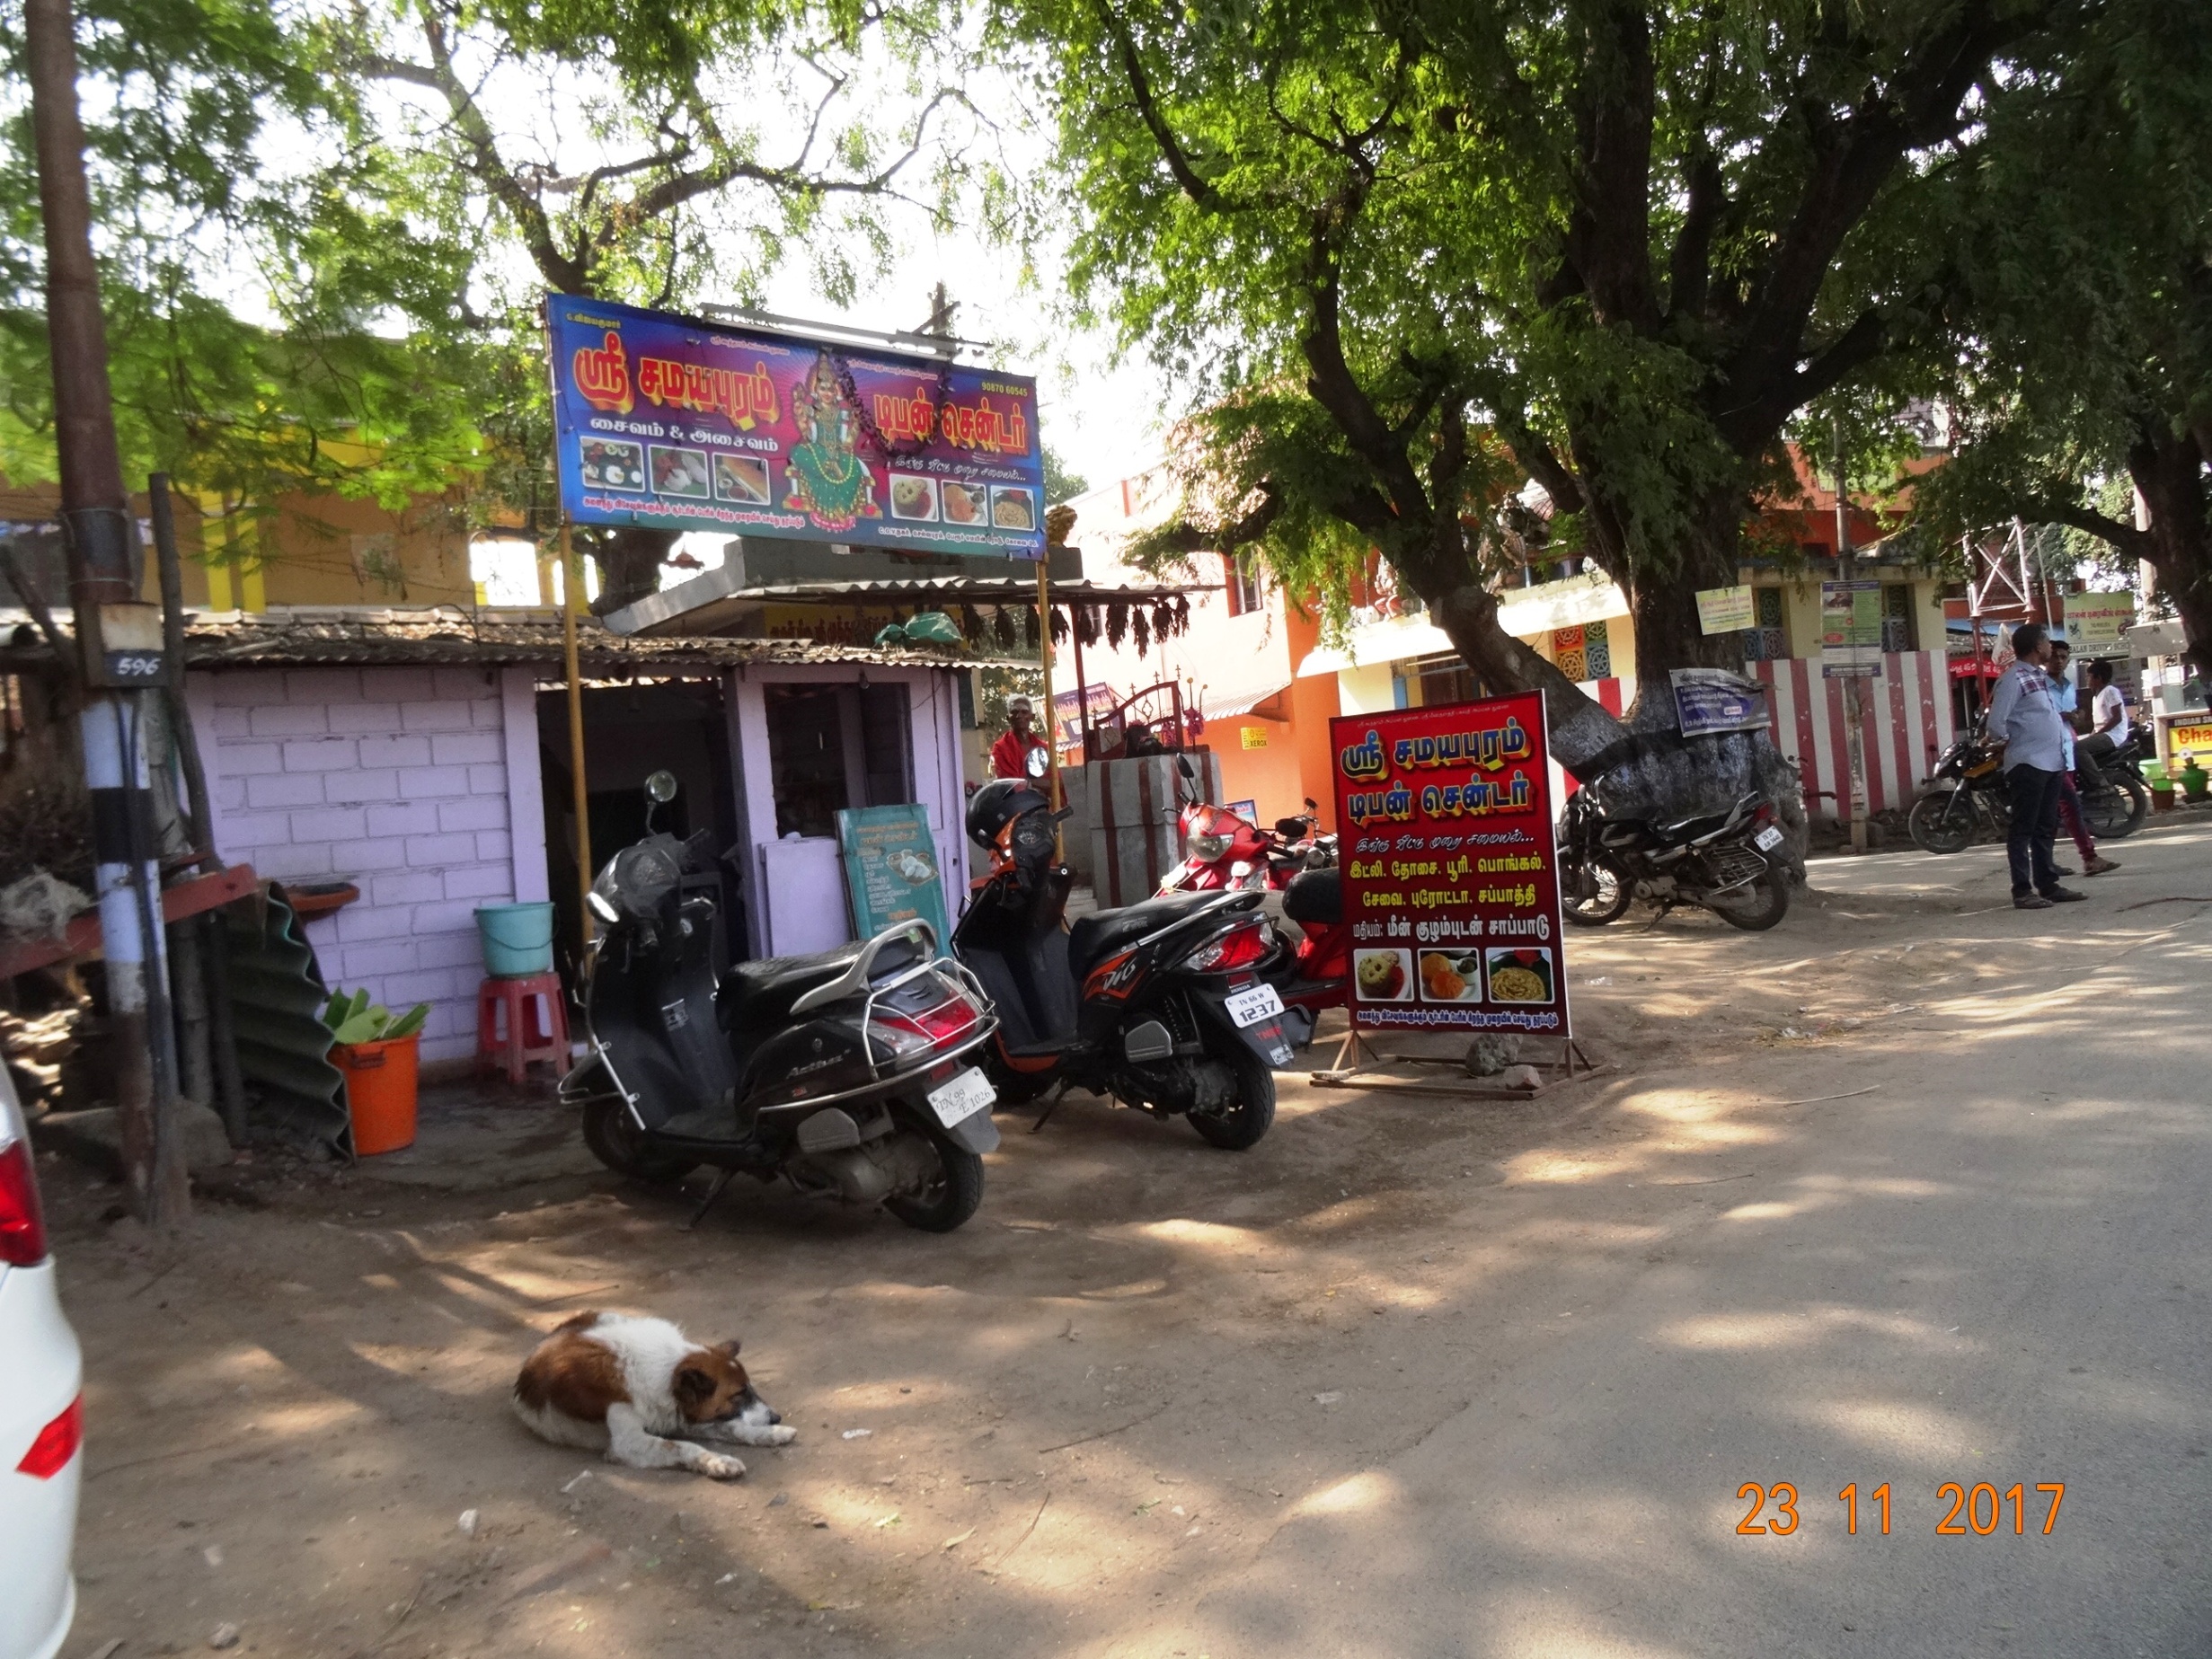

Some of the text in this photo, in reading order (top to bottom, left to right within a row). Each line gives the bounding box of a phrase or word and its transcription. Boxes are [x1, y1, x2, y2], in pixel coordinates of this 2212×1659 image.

[574, 331, 1027, 451] ஸ்ரீ சமயபுரம் டிபன் சென்டர்
[982, 382, 1028, 397] 90870 60545
[590, 417, 779, 452] சைவம் & அசைவம்
[895, 455, 924, 470] இங்கு
[928, 458, 951, 472] வீட்டு
[954, 463, 978, 479] முறை
[116, 657, 161, 677] 596
[1250, 739, 1267, 747] XEROX
[1341, 716, 1529, 780] ஸ்ரீ சமயபுரம்
[1349, 770, 1530, 827] டிபன் சென்டர்
[1356, 837, 1390, 852] இங்கு
[1395, 834, 1424, 851] வீட்டு
[1429, 835, 1462, 851] முறை
[1478, 883, 1535, 907] சப்பாத்தி
[1353, 913, 1550, 942] மதியம்: மீன் குழம்புடன் சாப்பாடு
[1230, 984, 1251, 994] HONDA
[1239, 998, 1248, 1006] TN
[1249, 994, 1258, 1002] 66
[1239, 1000, 1275, 1022] 1237
[936, 1088, 966, 1111] TN 99
[959, 1088, 991, 1114] E 1026
